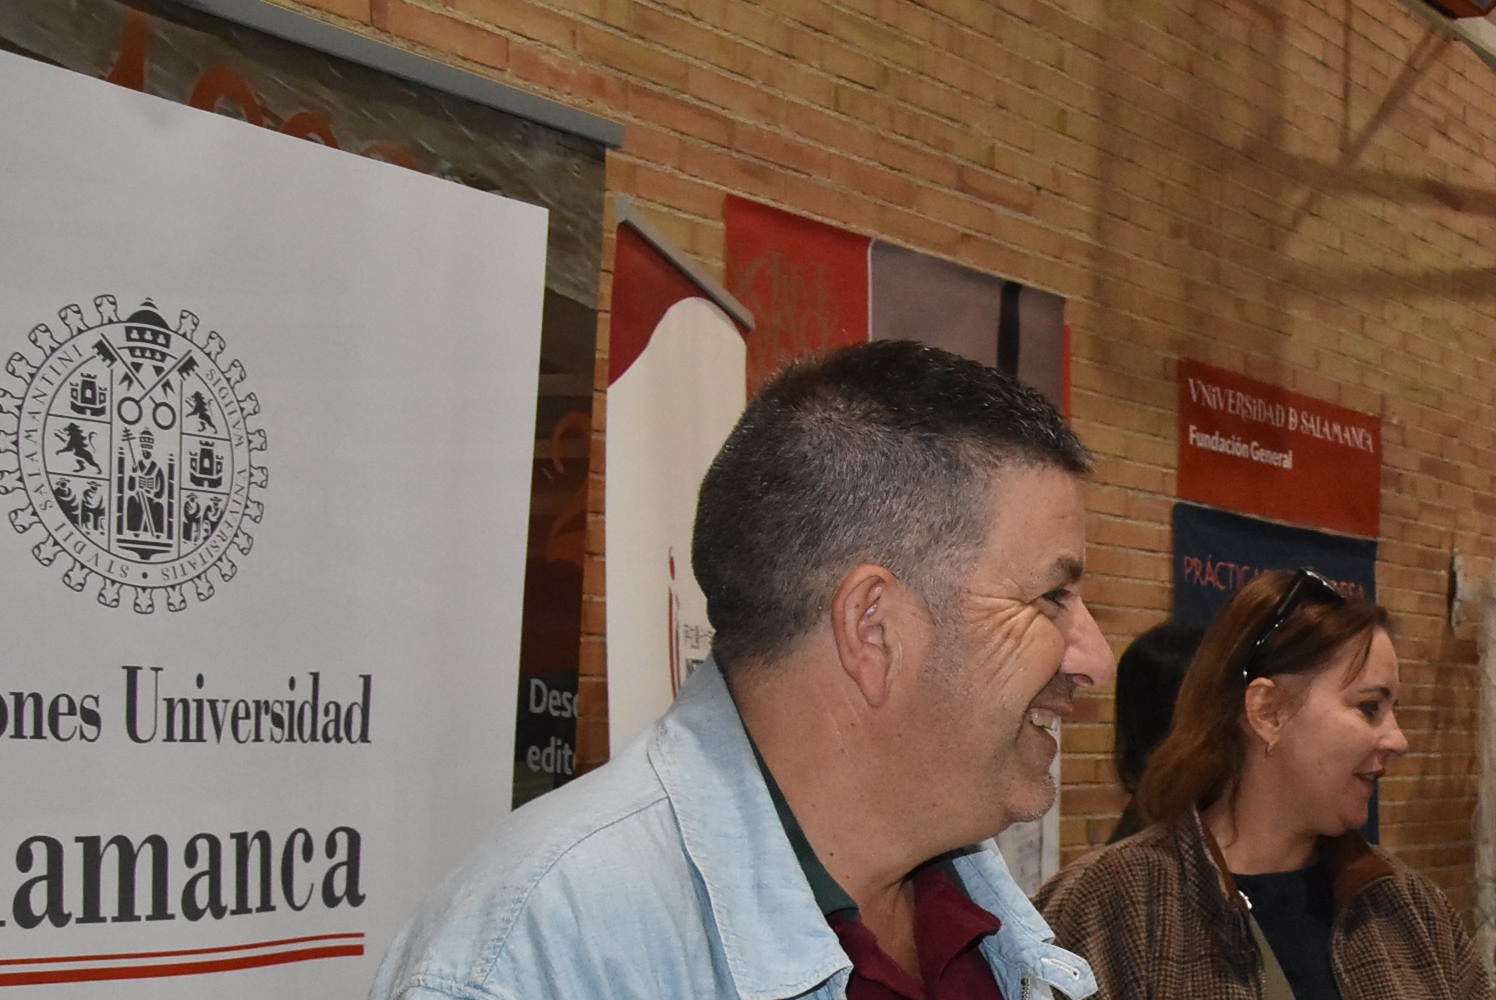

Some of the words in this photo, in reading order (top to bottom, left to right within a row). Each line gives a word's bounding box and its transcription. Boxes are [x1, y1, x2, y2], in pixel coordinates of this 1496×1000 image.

[1189, 424, 1251, 457] Fundación
[1250, 441, 1294, 469] General
[1299, 411, 1374, 453] SALAMANCA
[1183, 554, 1259, 591] PRÁCTIC
[121, 665, 372, 744] Universidad
[528, 677, 579, 719] Des
[526, 736, 577, 775] edit
[0, 826, 366, 930] amanca
